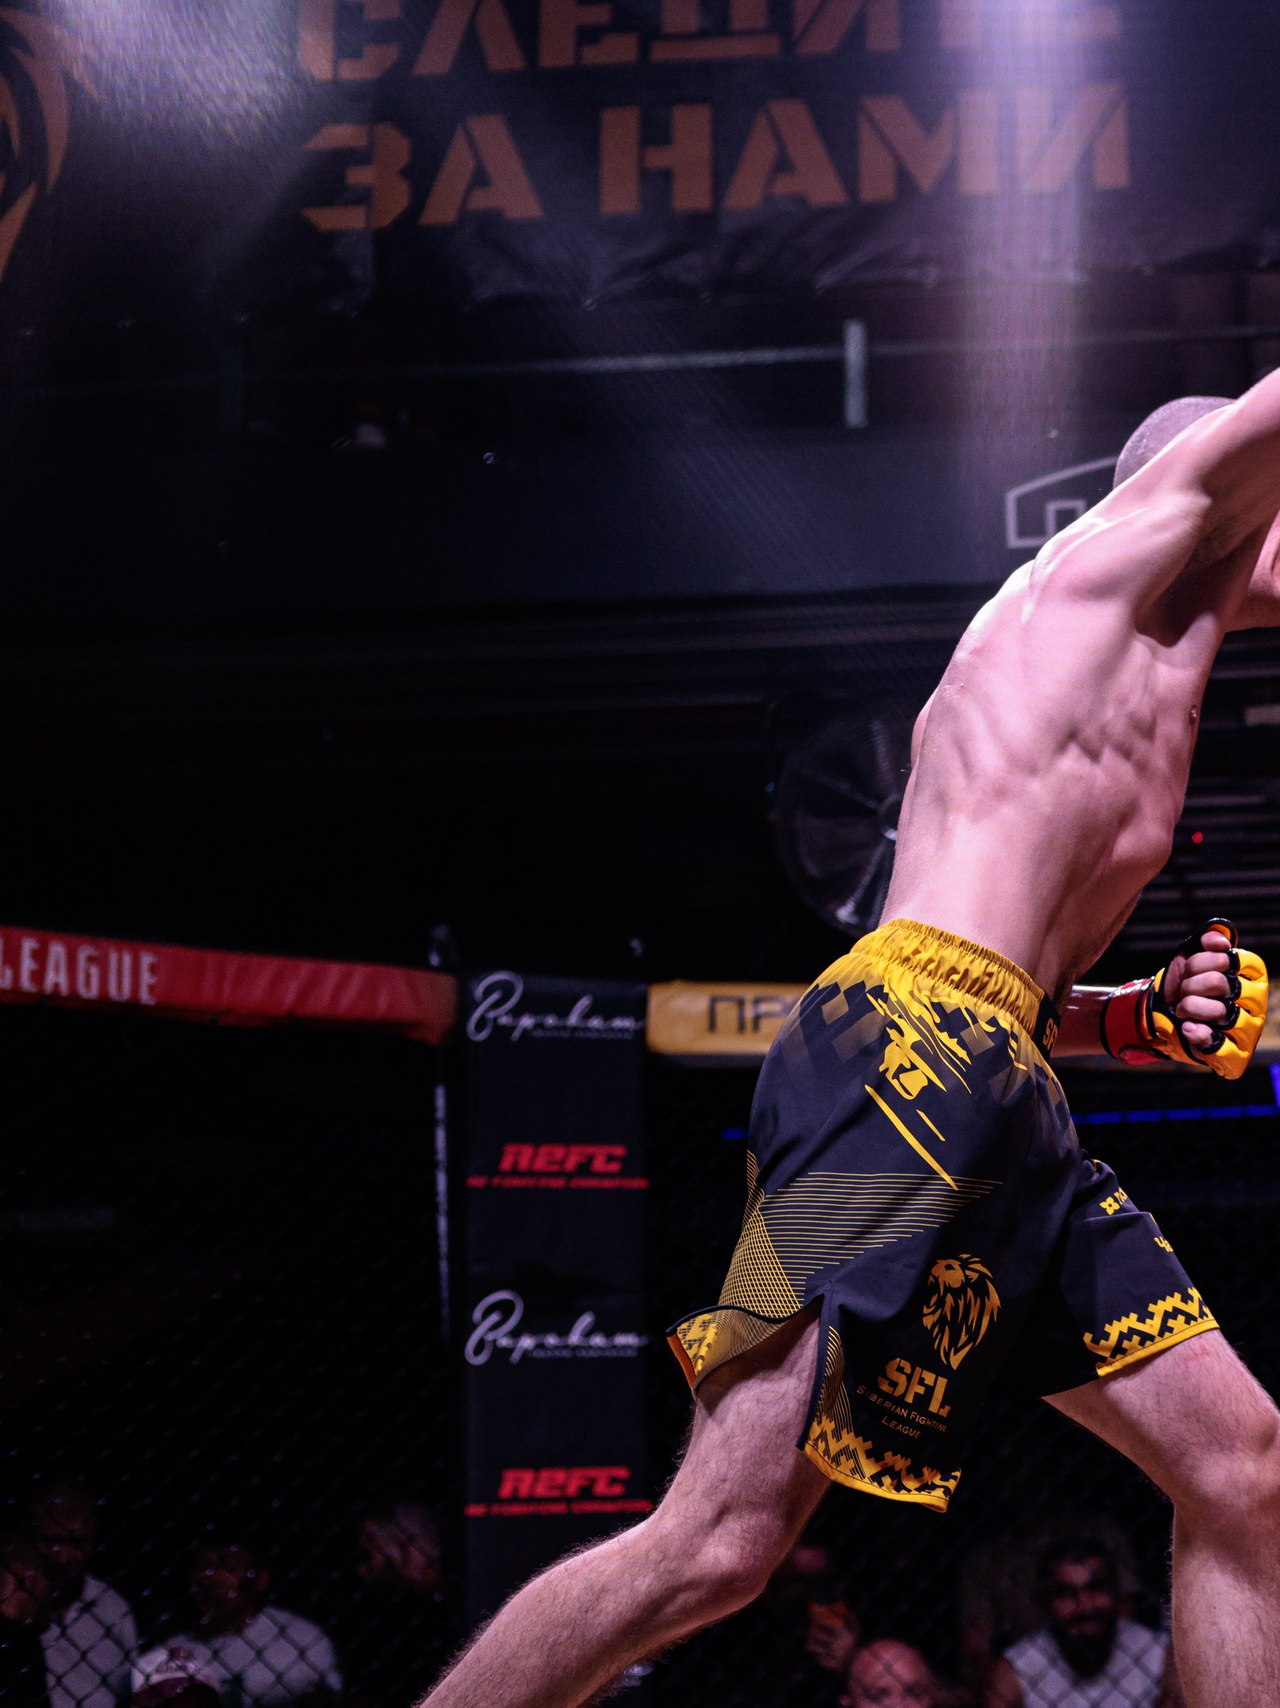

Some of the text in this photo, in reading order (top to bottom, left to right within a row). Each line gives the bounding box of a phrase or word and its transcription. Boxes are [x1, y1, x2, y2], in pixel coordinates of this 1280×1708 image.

[301, 82, 1131, 231] ЗА НАМИ
[1042, 1017, 1058, 1051] SF
[856, 1385, 908, 1418] SIBERIAN
[877, 1357, 952, 1418] SFL
[881, 1415, 922, 1439] LEAGUE
